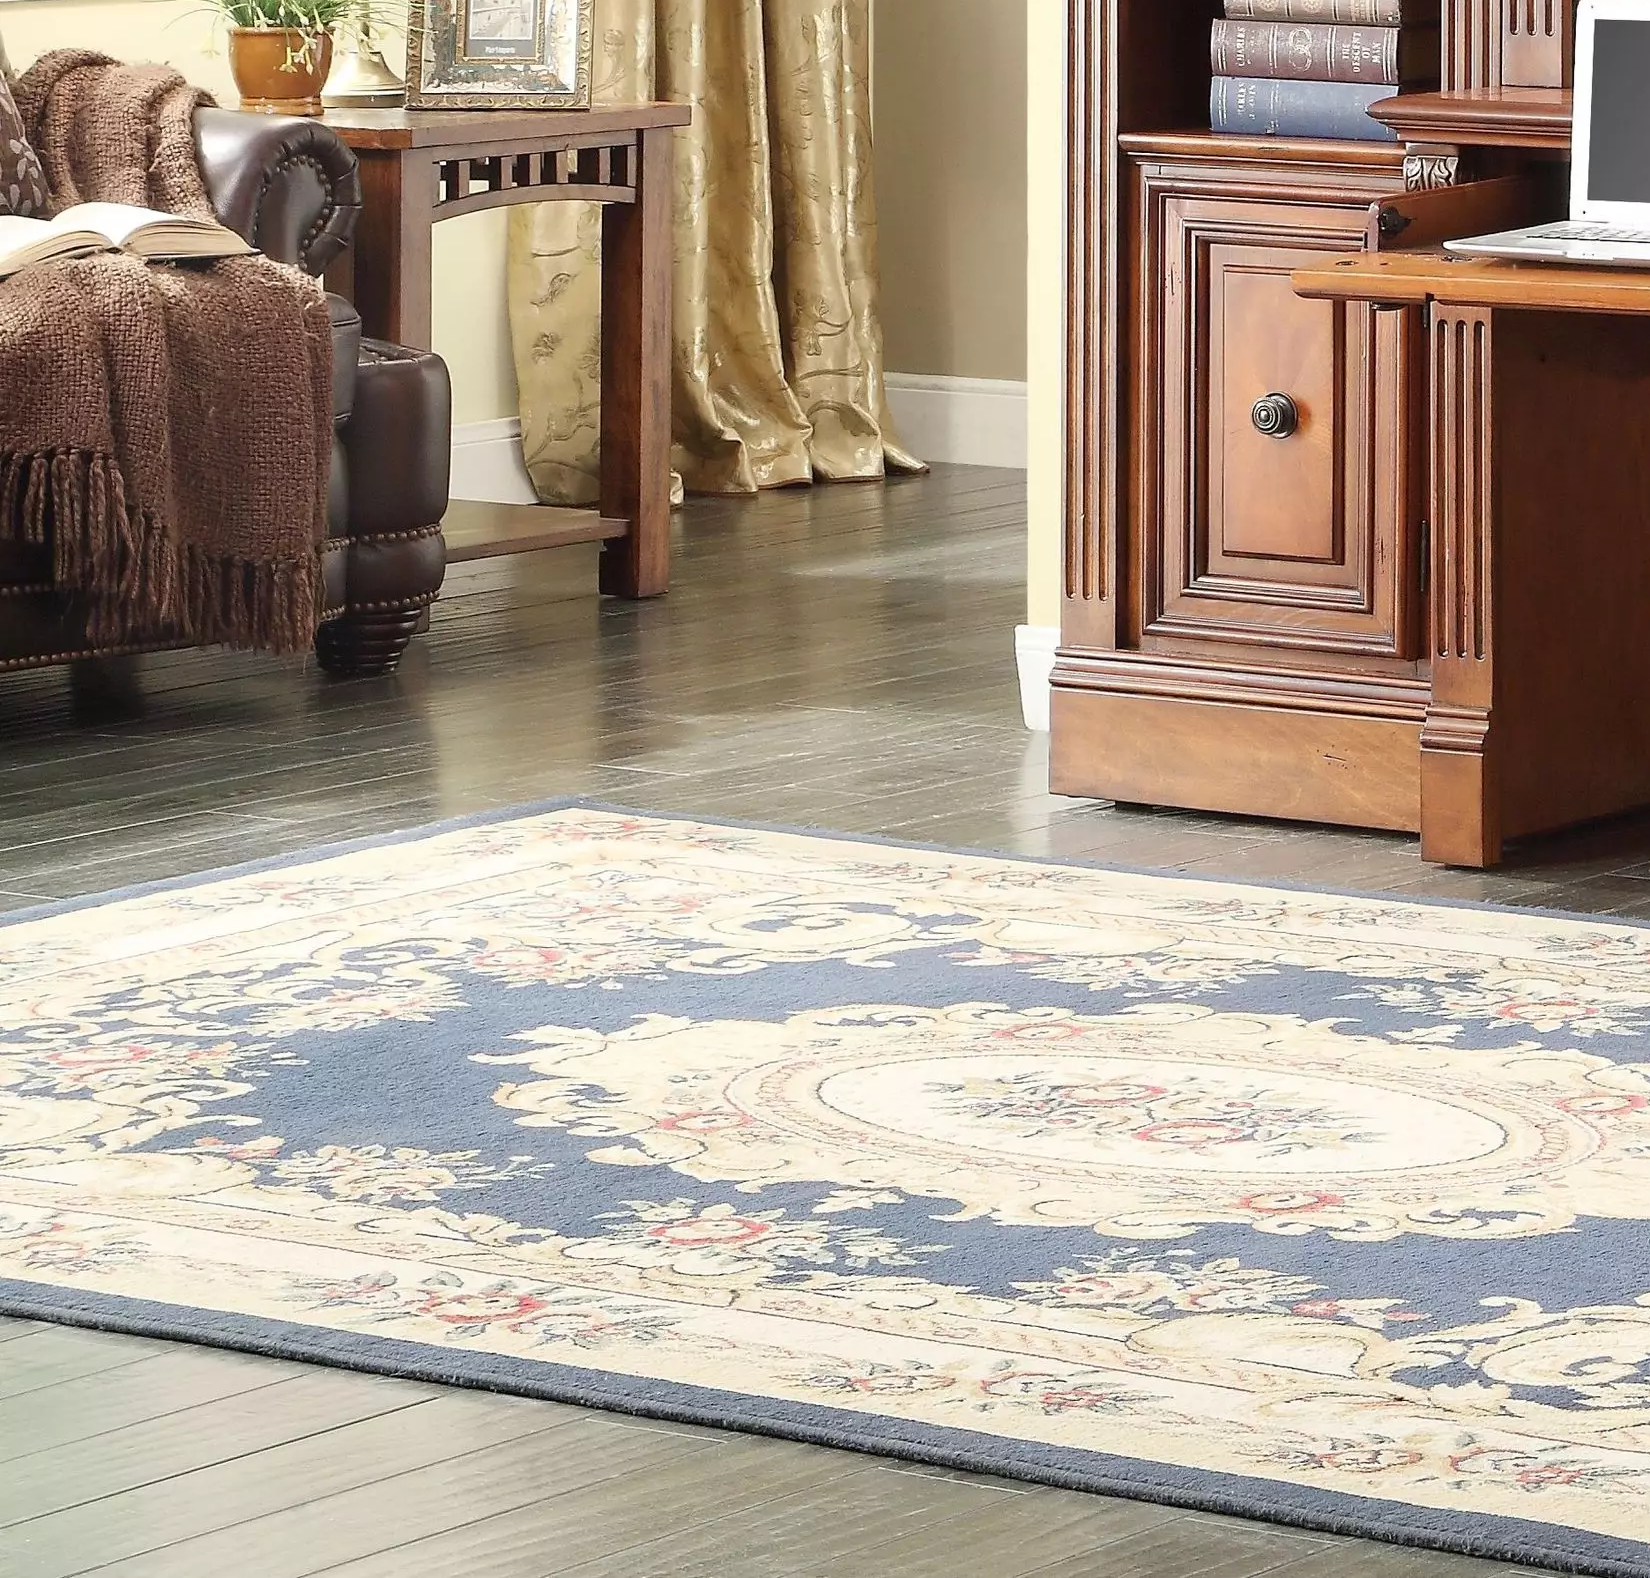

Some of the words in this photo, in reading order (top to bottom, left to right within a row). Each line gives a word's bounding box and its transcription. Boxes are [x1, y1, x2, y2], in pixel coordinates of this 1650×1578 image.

[1236, 26, 1246, 68] CHARLES
[1341, 42, 1351, 60] THE
[1351, 31, 1362, 73] DESCENT
[1361, 46, 1371, 59] OF
[1371, 41, 1382, 64] MAN
